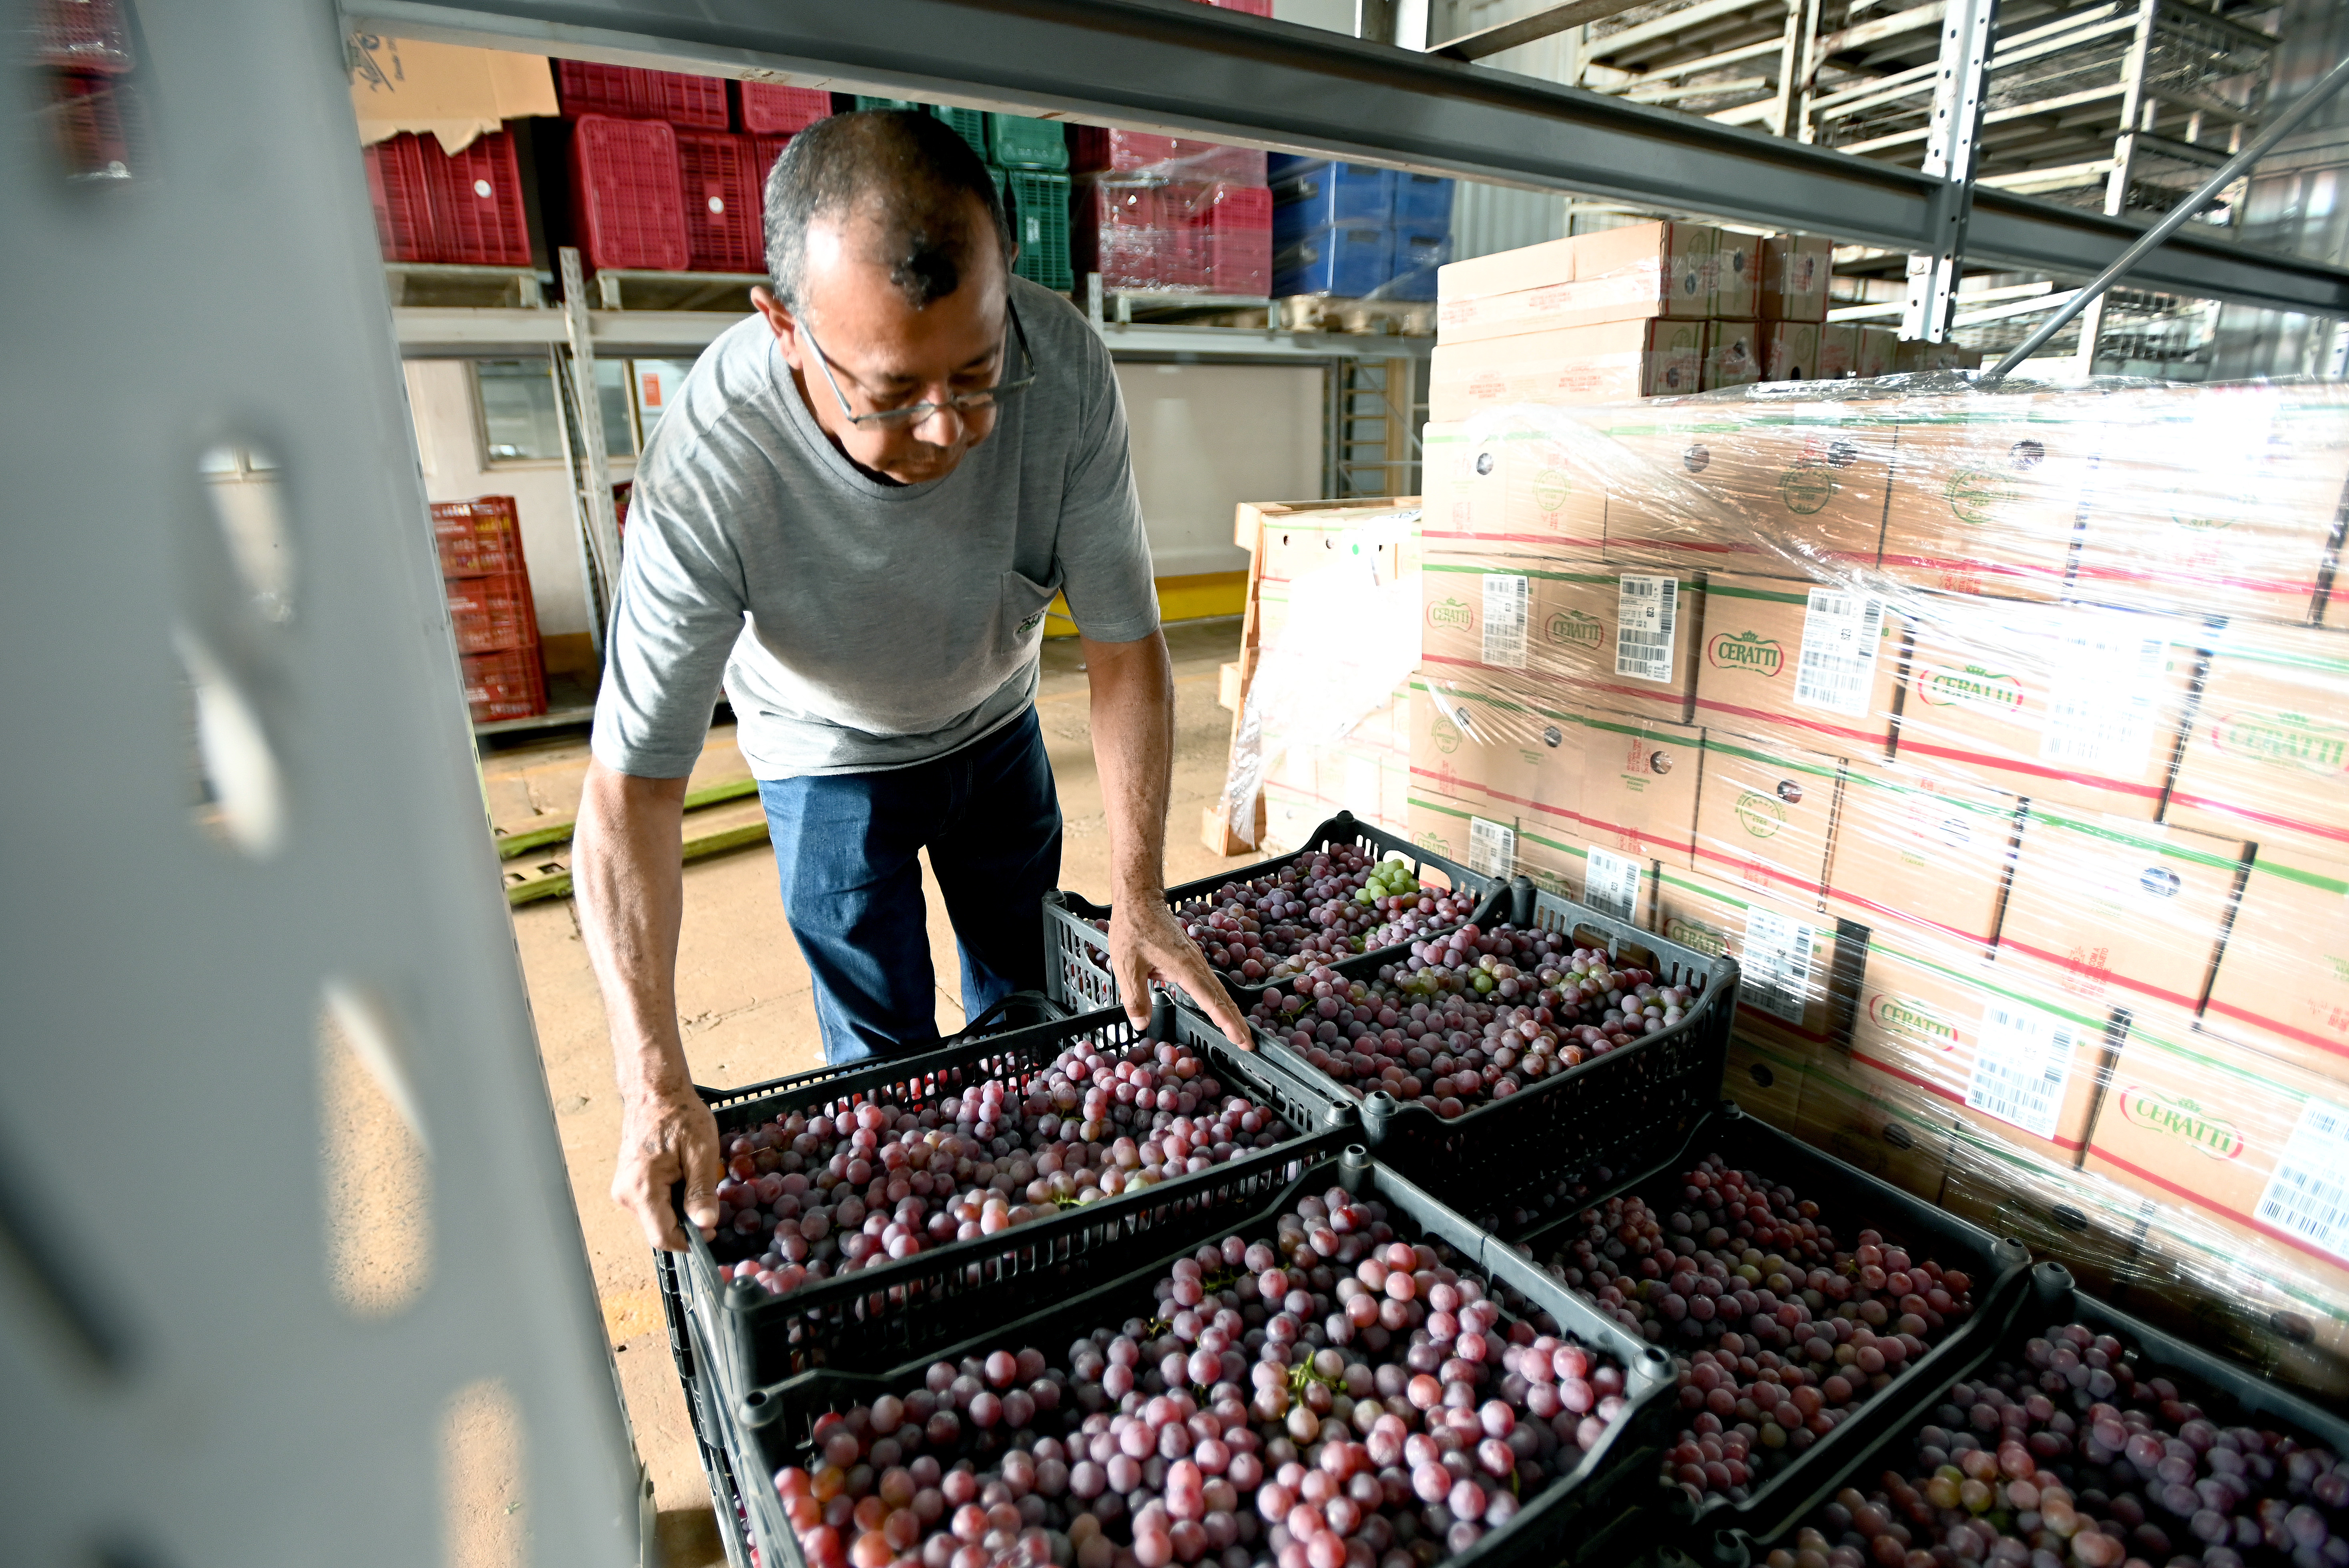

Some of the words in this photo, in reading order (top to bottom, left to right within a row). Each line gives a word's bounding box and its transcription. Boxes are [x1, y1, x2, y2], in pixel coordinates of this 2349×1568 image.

[1433, 608, 1470, 623] CERATTI
[1553, 620, 1600, 640] CERATTI
[1719, 642, 1778, 667] CERATTI
[1932, 675, 2013, 703] CERATTI
[2229, 725, 2345, 764] CERATTI
[2088, 953, 2098, 966] COM
[2096, 948, 2108, 970] OBJETO
[1881, 1004, 1949, 1037] CERATTI
[2136, 1099, 2231, 1152] CERATTI
